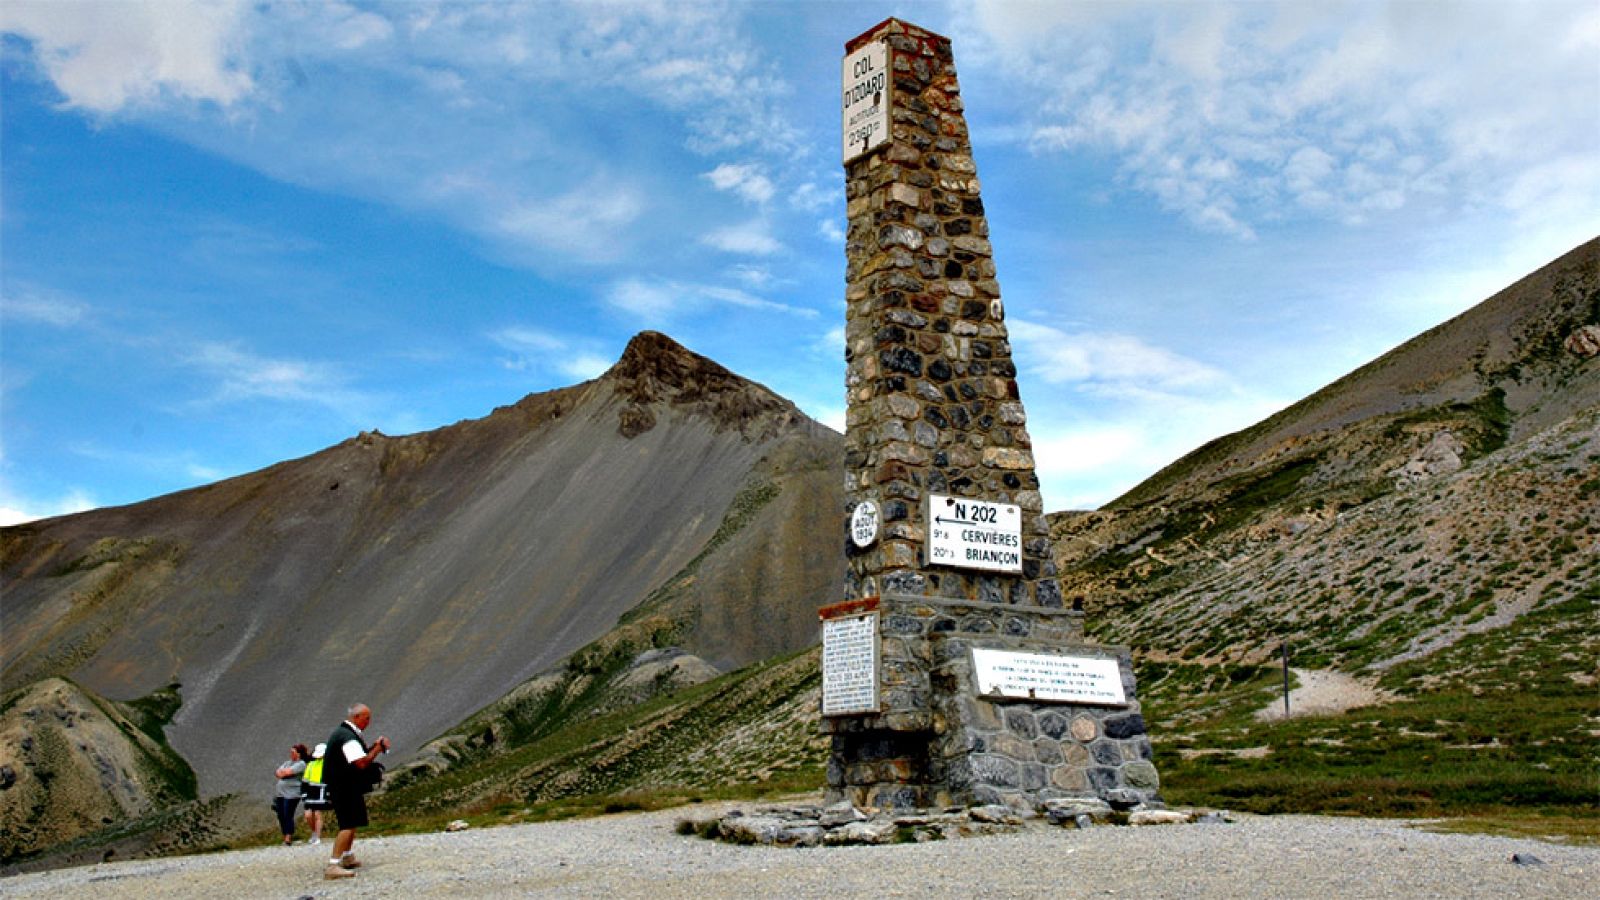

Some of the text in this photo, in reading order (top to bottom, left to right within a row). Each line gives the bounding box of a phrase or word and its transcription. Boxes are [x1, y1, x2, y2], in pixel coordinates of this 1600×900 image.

[854, 55, 874, 78] COL
[955, 503, 997, 523] N 202
[966, 548, 1018, 564] BRIANÇON
